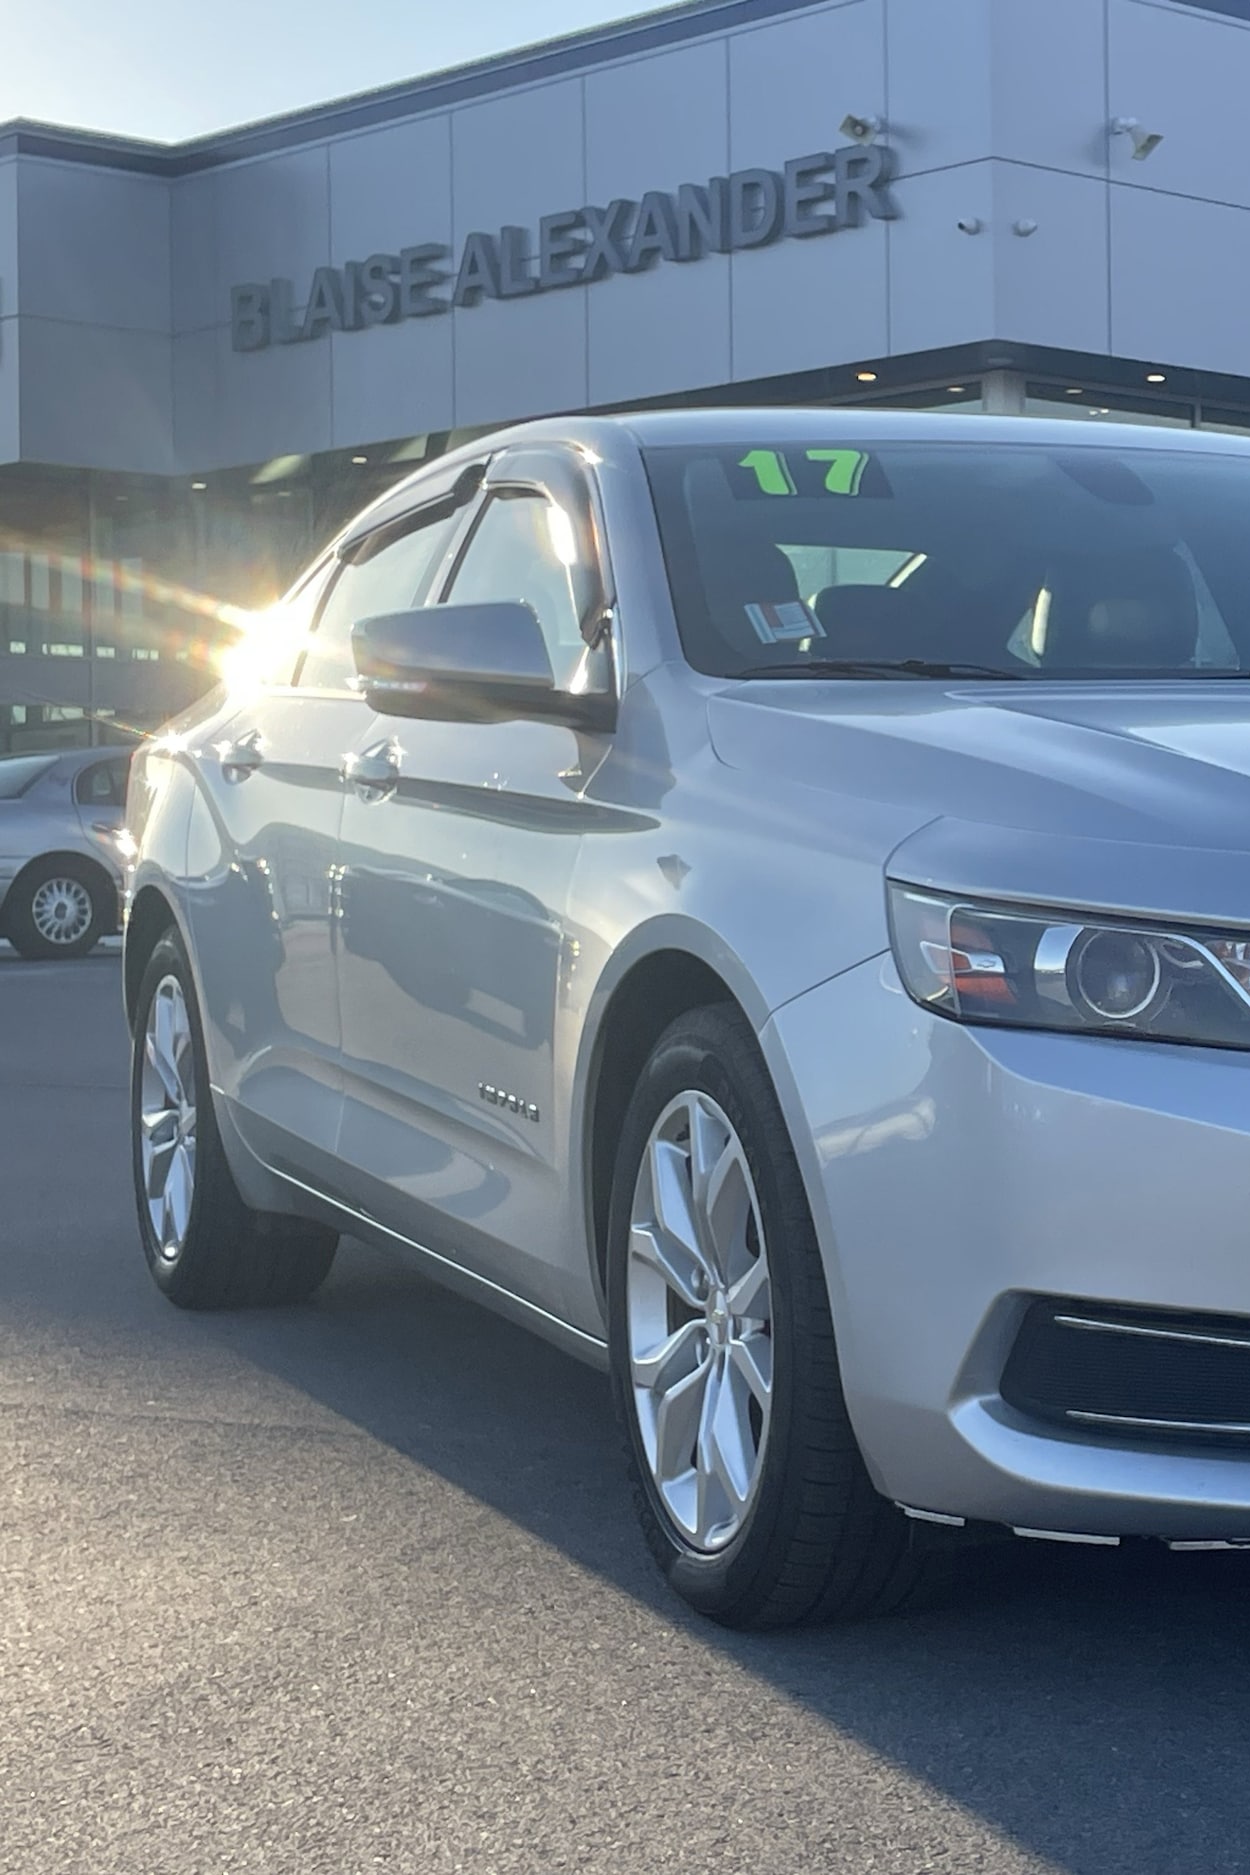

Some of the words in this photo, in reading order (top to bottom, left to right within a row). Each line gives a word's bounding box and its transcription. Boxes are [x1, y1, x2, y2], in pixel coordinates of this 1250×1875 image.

[231, 243, 452, 353] BLAISE
[453, 144, 903, 308] ALEXANDER
[737, 449, 869, 496] 17
